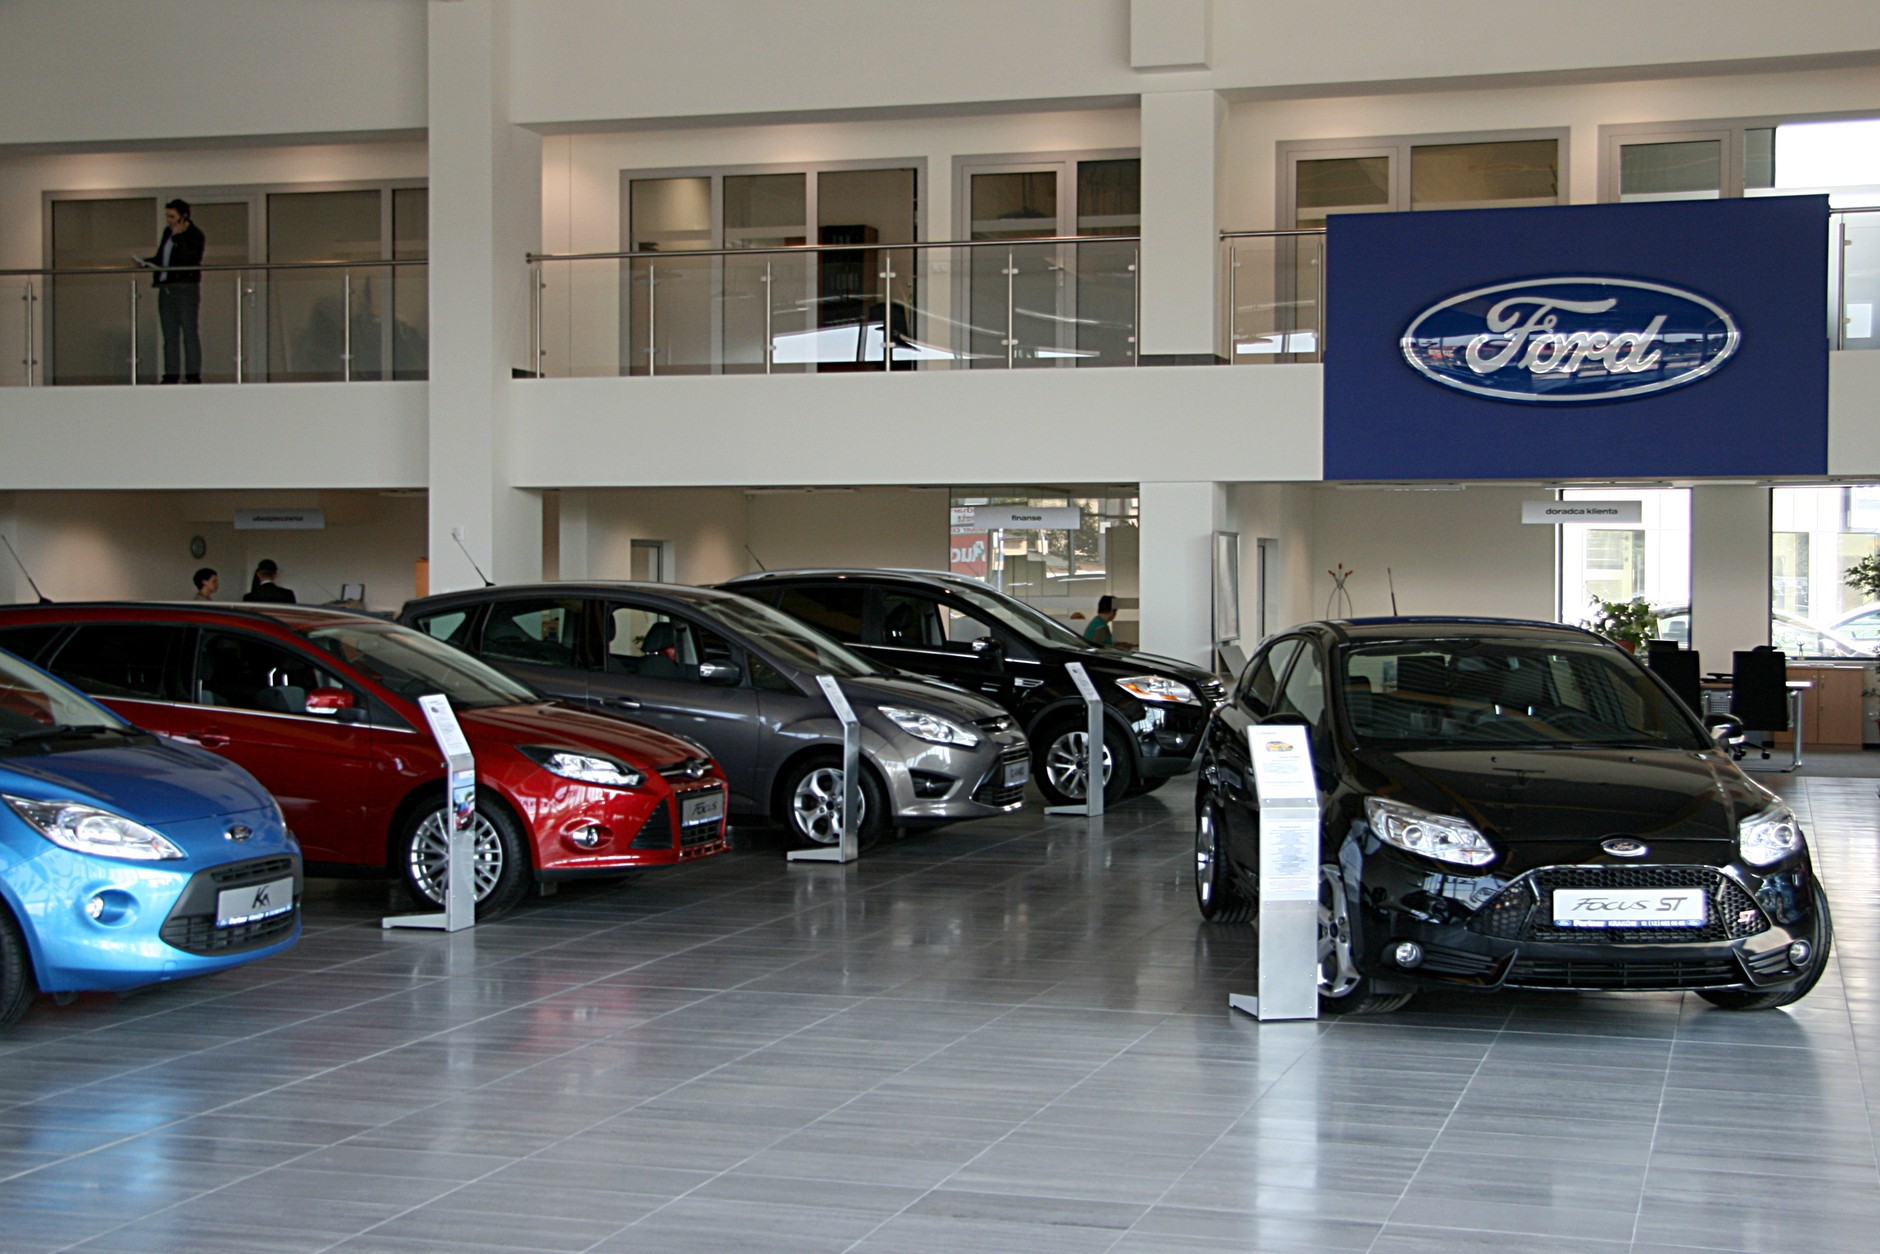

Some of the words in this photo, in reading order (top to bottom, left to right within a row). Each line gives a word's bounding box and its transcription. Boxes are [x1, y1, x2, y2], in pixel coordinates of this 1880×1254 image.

[1465, 296, 1668, 374] Ford
[1545, 507, 1585, 515] doradca
[1586, 507, 1618, 515] klienta
[1011, 514, 1042, 522] finanse
[1655, 896, 1688, 911] ST
